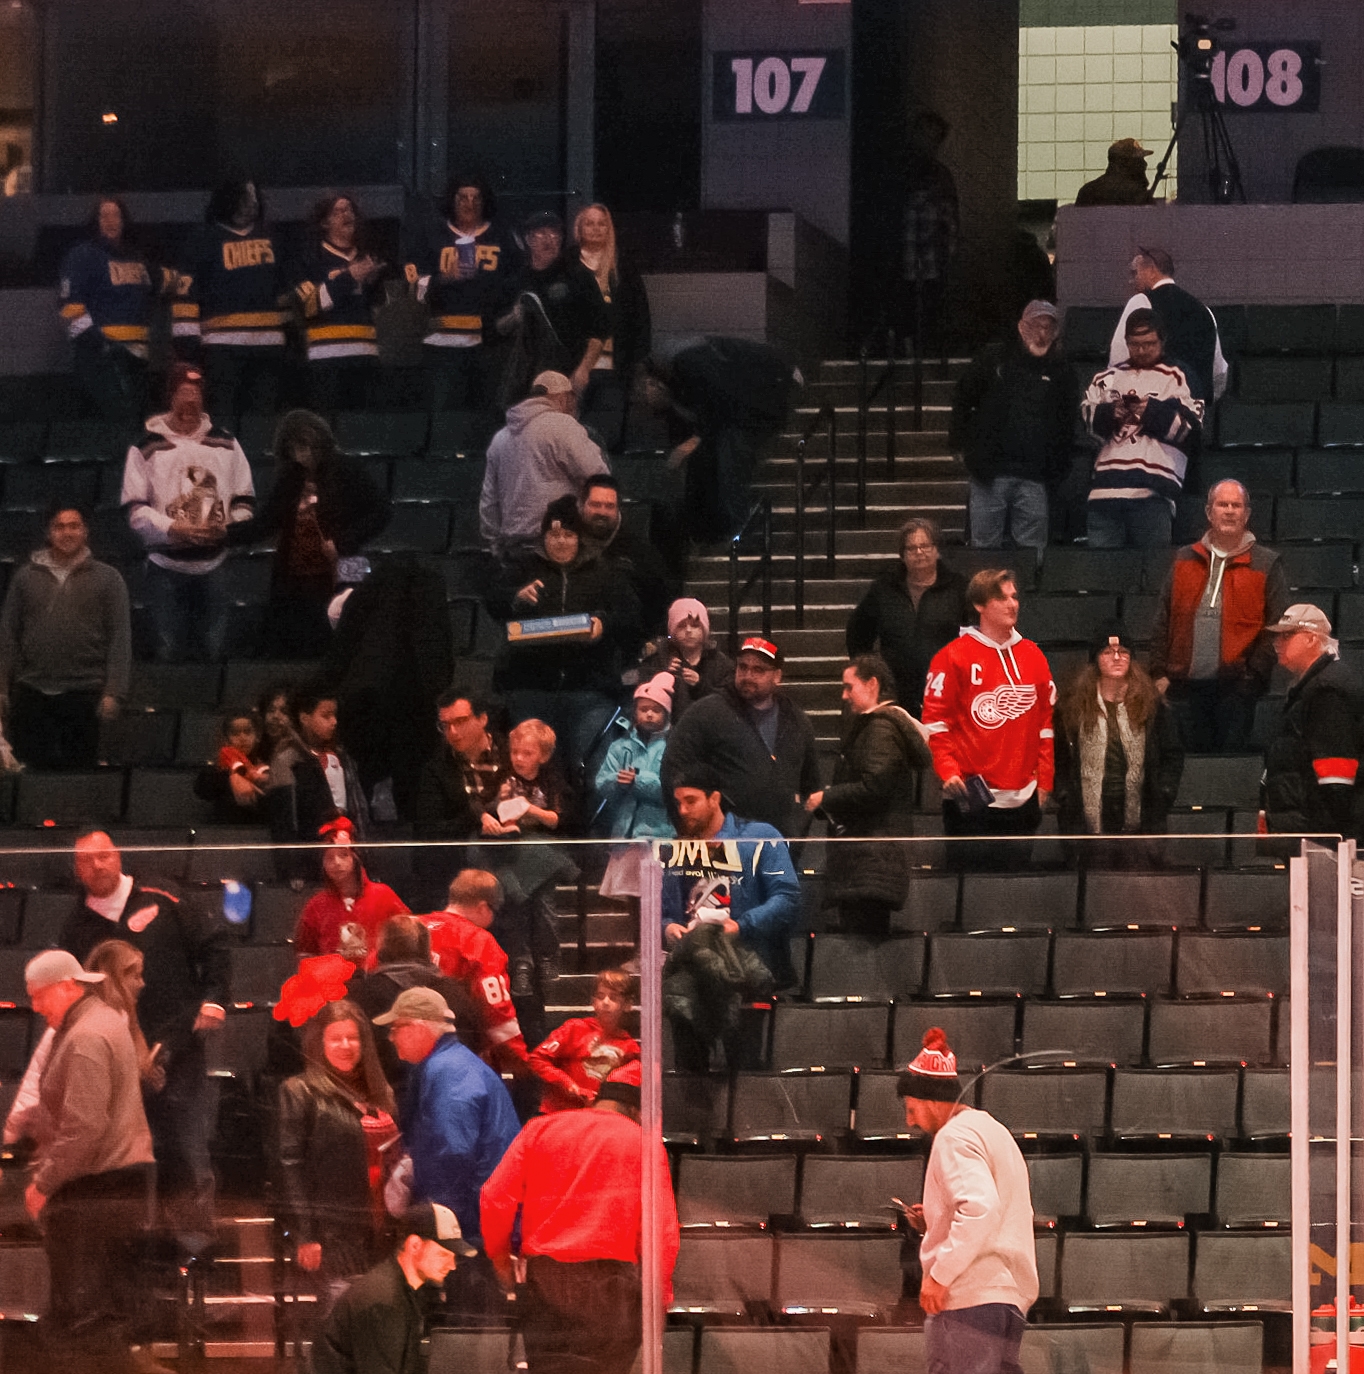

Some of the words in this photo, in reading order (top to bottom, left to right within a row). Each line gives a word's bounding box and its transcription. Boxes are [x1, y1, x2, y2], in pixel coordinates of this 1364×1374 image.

[731, 56, 827, 115] 107
[1210, 48, 1303, 107] 108
[970, 663, 983, 686] C
